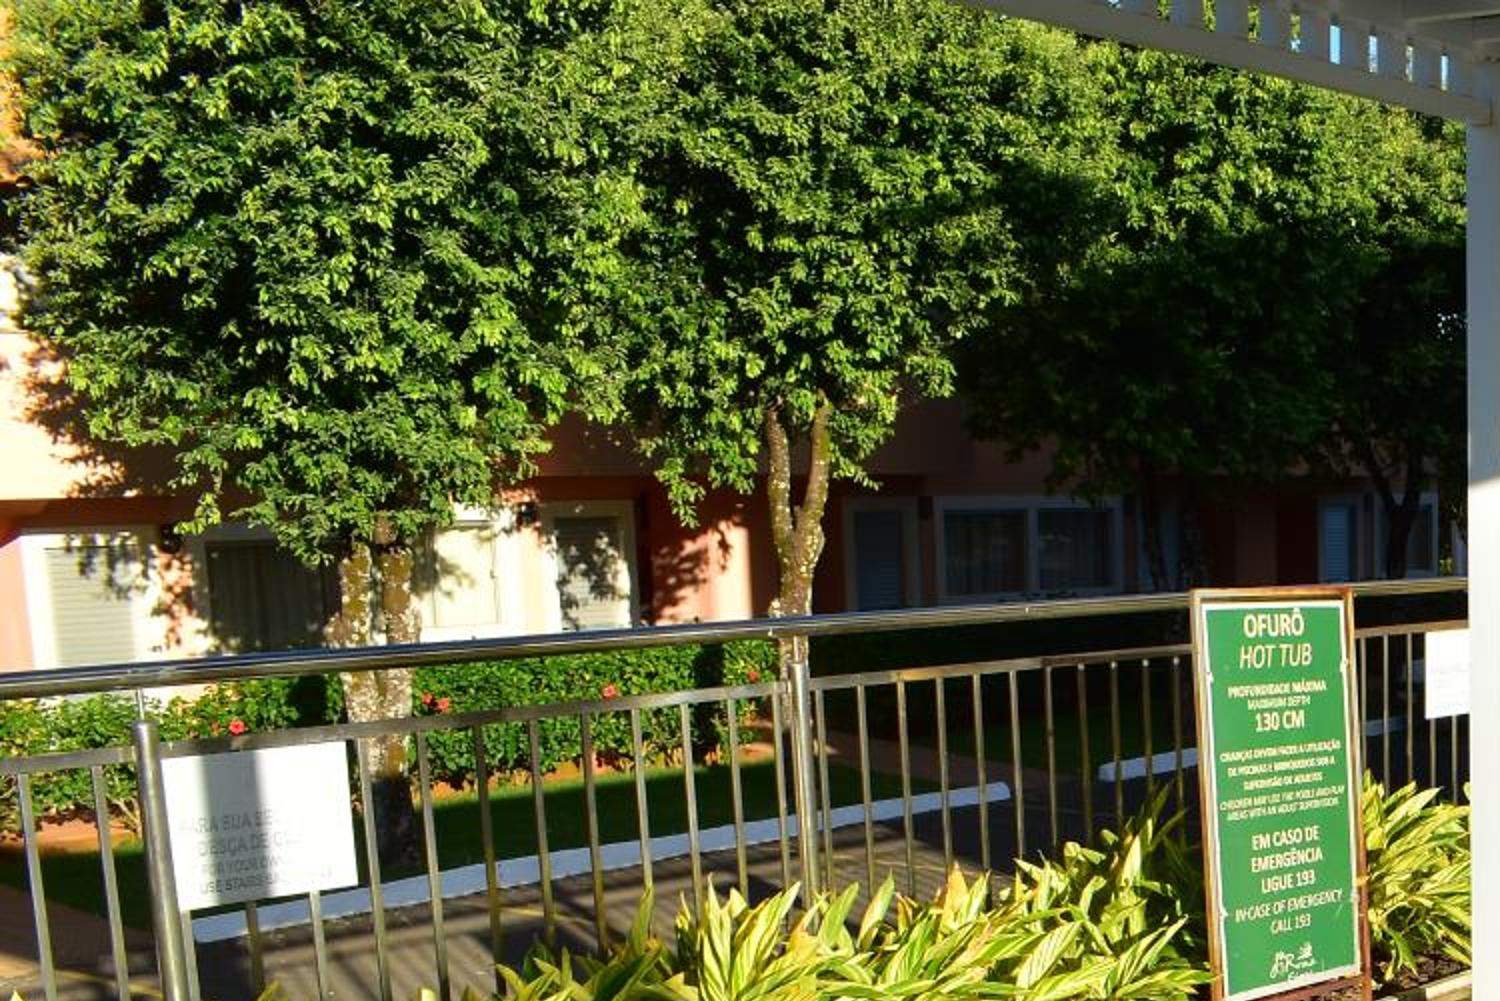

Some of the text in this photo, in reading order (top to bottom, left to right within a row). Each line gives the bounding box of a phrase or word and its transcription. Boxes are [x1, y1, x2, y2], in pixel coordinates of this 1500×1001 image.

[1244, 607, 1304, 638] OFURÔ
[1240, 643, 1313, 669] HOT TUB
[1255, 709, 1305, 733] 130 CM
[1252, 825, 1320, 850] EM CASO DE
[1251, 847, 1323, 873] EMERGÊNCIA
[1262, 869, 1316, 893] LIGUE 193
[1235, 889, 1342, 922] IN CASE OF EMERGENCY
[1270, 913, 1311, 934] CALL 193
